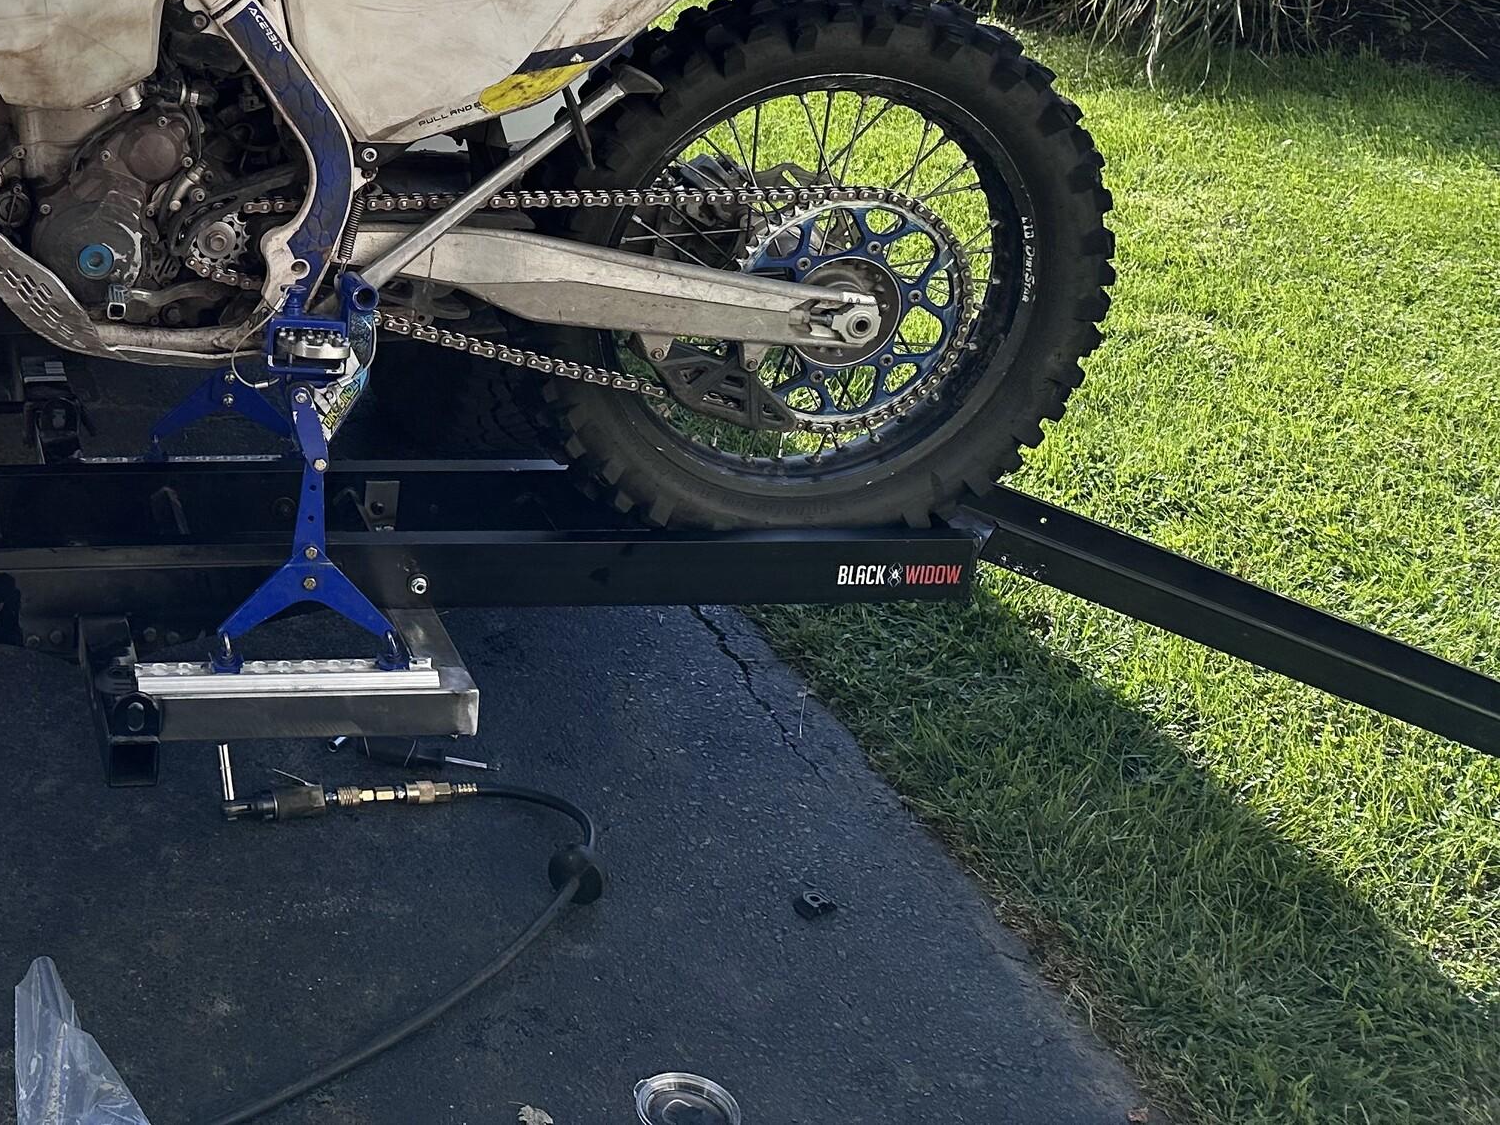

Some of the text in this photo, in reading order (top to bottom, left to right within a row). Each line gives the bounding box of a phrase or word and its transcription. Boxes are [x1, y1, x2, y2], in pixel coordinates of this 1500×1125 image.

[248, 7, 283, 53] ACERBIS
[418, 114, 449, 127] PULL
[449, 104, 473, 117] AND
[837, 565, 962, 586] BLACK WIDOW
